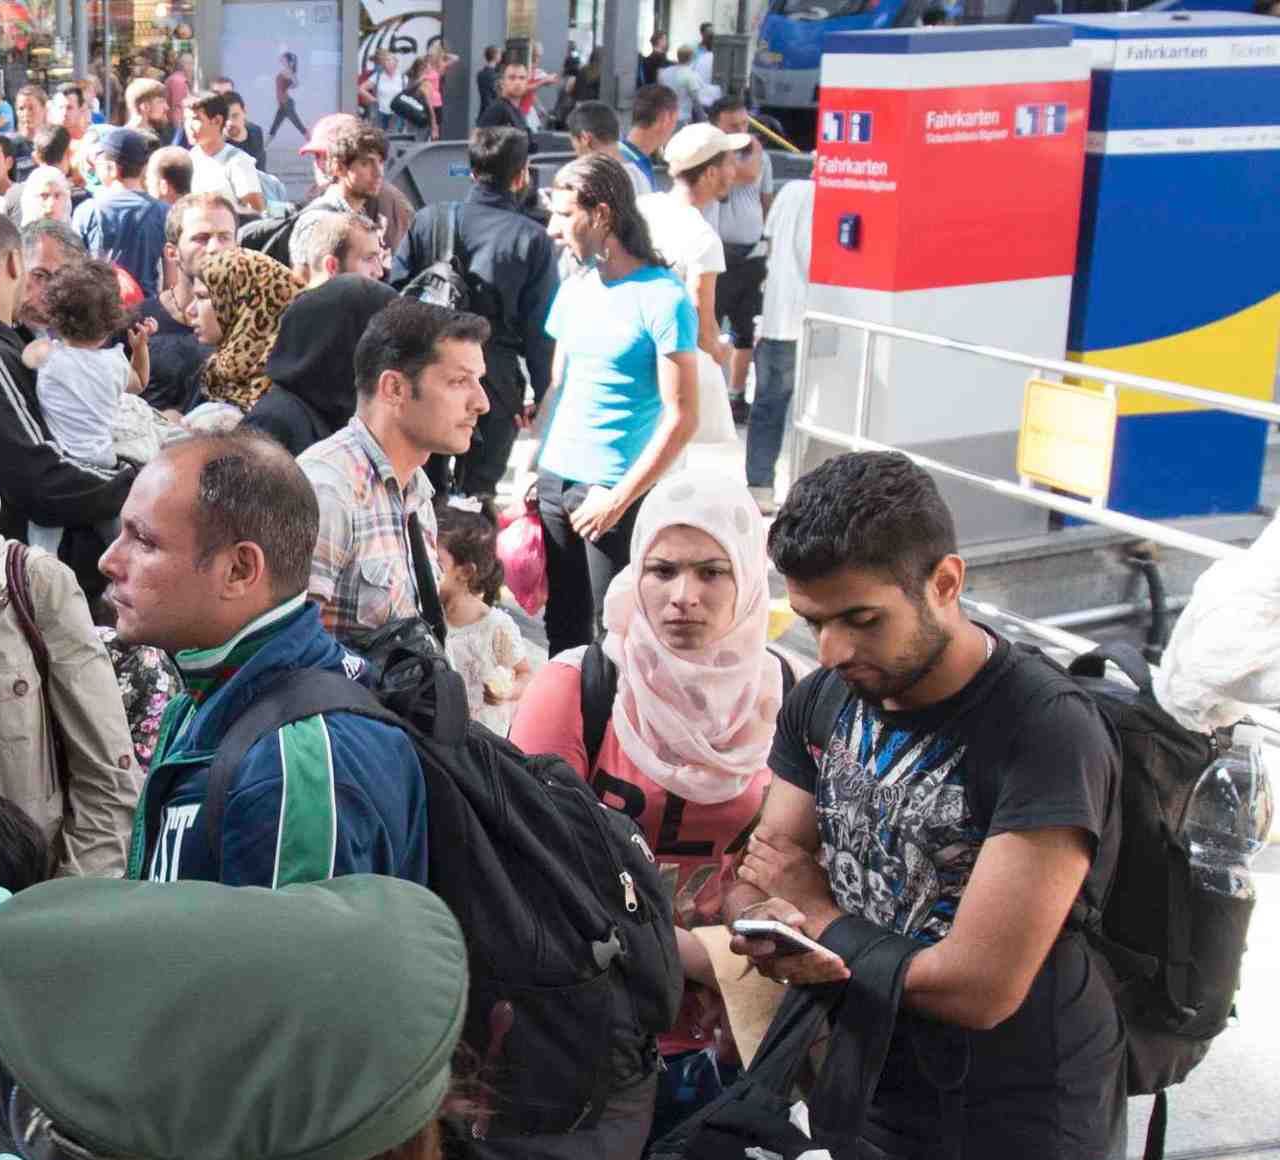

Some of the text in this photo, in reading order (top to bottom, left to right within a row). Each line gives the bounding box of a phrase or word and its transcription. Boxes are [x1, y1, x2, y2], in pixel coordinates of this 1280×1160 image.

[1127, 43, 1208, 61] Fahrkarten
[925, 108, 1000, 129] Fahrkarten
[818, 155, 888, 177] Fahrkarten
